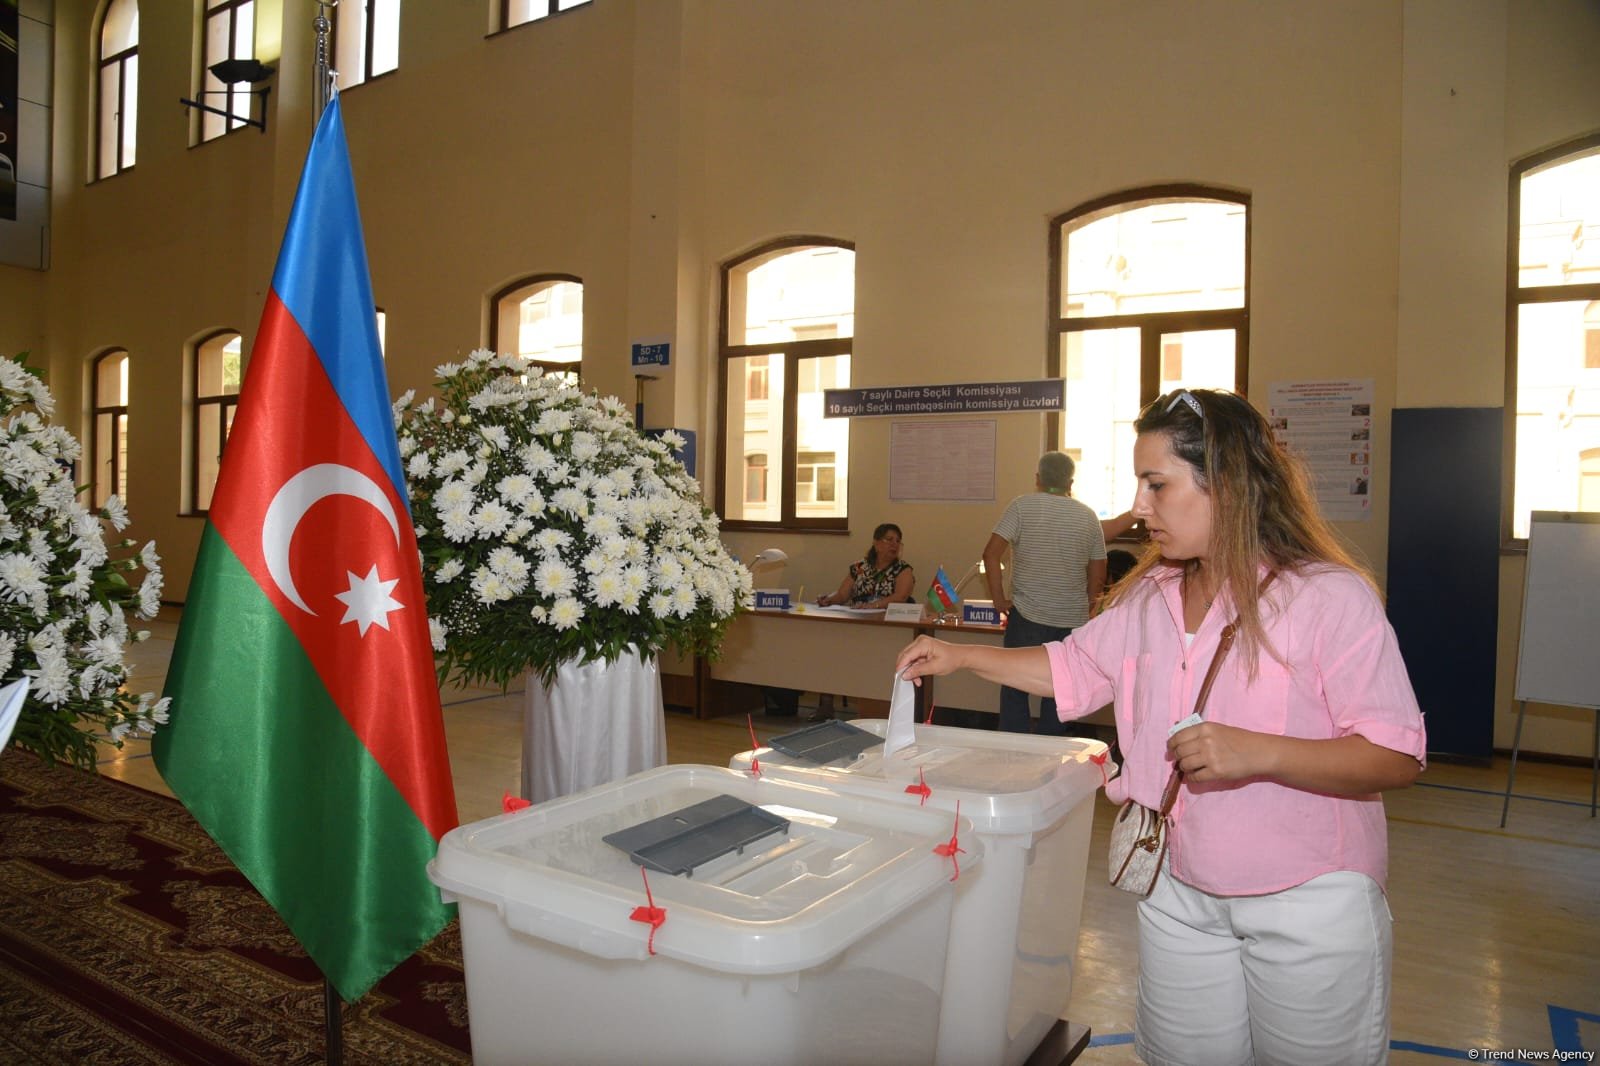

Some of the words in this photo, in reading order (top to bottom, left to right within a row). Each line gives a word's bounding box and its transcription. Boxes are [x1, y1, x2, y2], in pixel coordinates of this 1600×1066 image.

[655, 354, 663, 362] 10
[861, 391, 867, 400] 7
[869, 390, 892, 402] saylı
[894, 389, 920, 399] Dairə
[923, 386, 951, 399] Seçki
[956, 385, 1021, 397] Komissiyası
[829, 404, 840, 414] 10
[842, 403, 864, 415] saylı
[866, 402, 893, 414] Seçki
[895, 399, 963, 411] məntəqəsinin
[965, 398, 1019, 410] komissiya
[1022, 396, 1060, 407] üzvləri
[969, 609, 995, 621] KATİB
